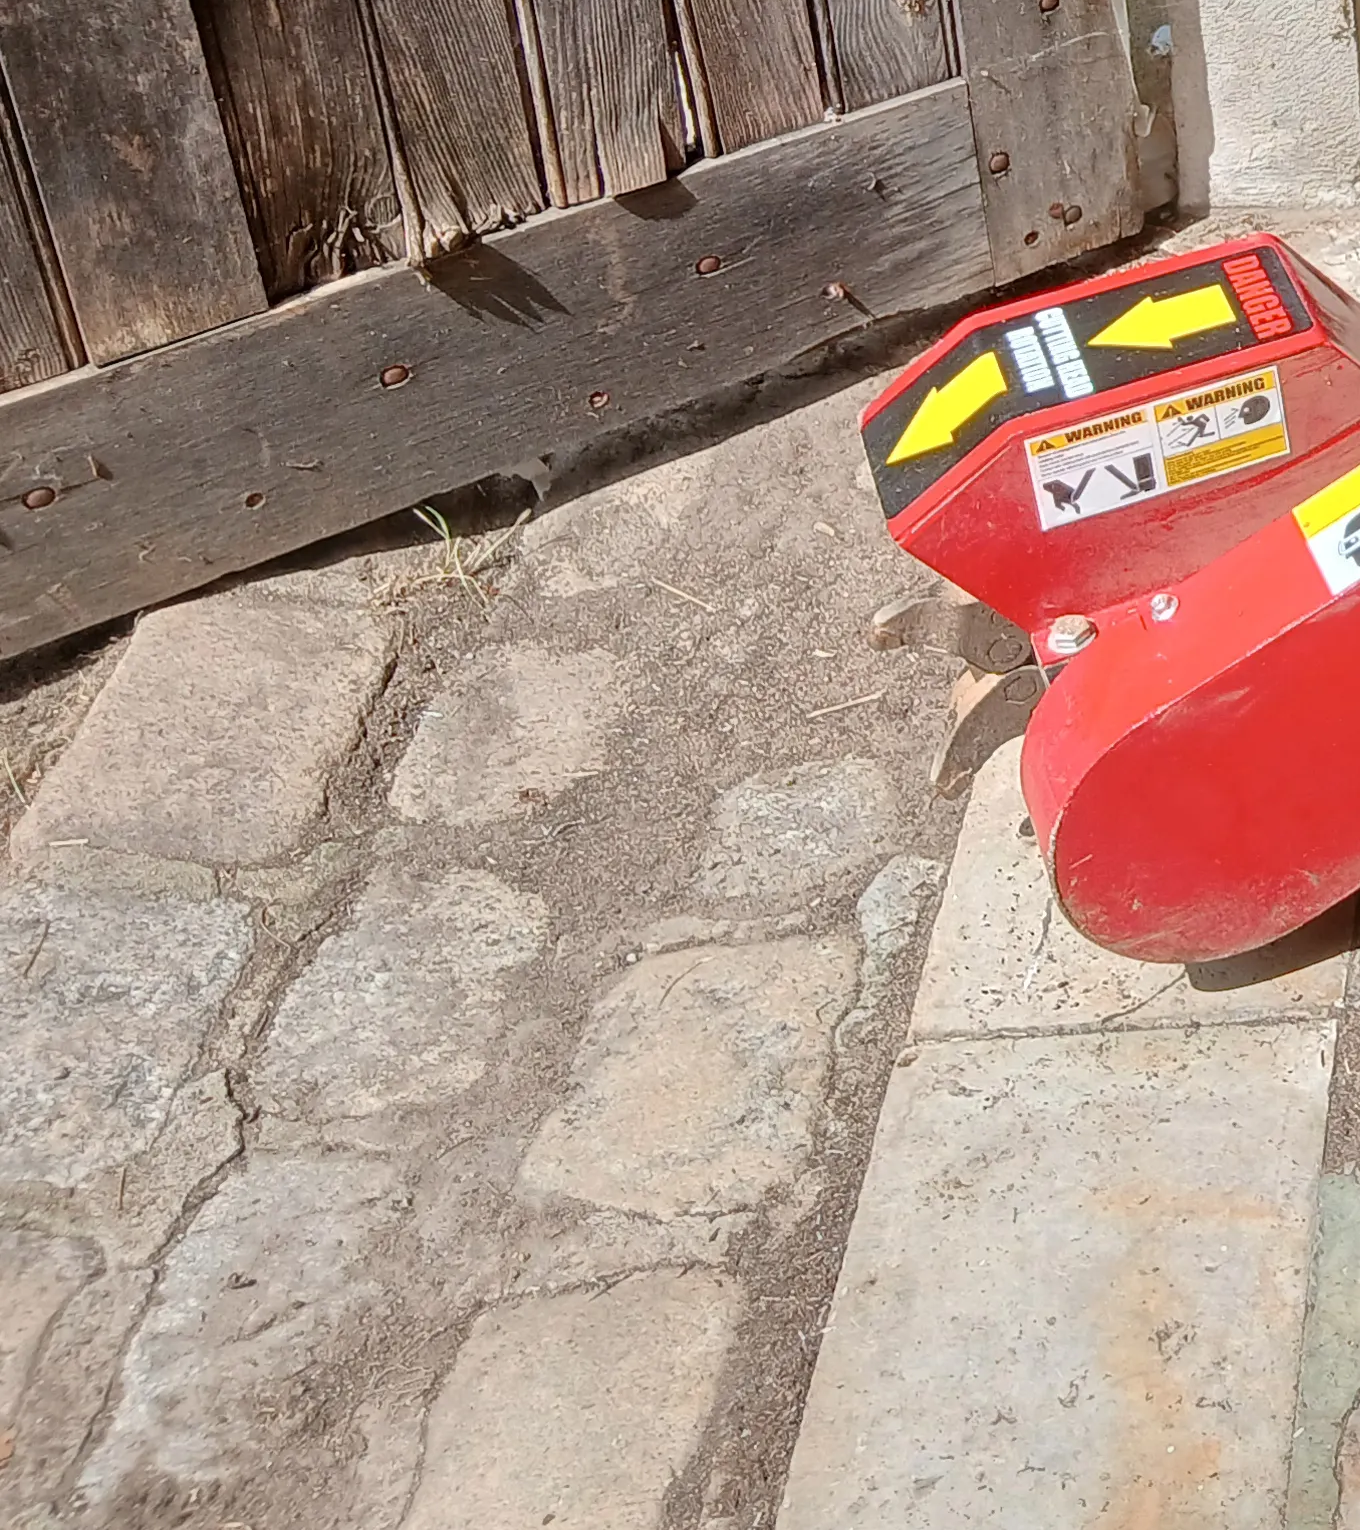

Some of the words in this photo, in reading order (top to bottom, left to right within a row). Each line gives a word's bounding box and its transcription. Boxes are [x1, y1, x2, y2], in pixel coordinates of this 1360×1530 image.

[1222, 254, 1294, 343] DANGER
[1005, 326, 1055, 393] ROTATION
[1034, 306, 1081, 366] CUTTING
[1055, 358, 1094, 400] HEAD
[1185, 377, 1265, 411] WARNING
[1064, 410, 1142, 443] WARNING
